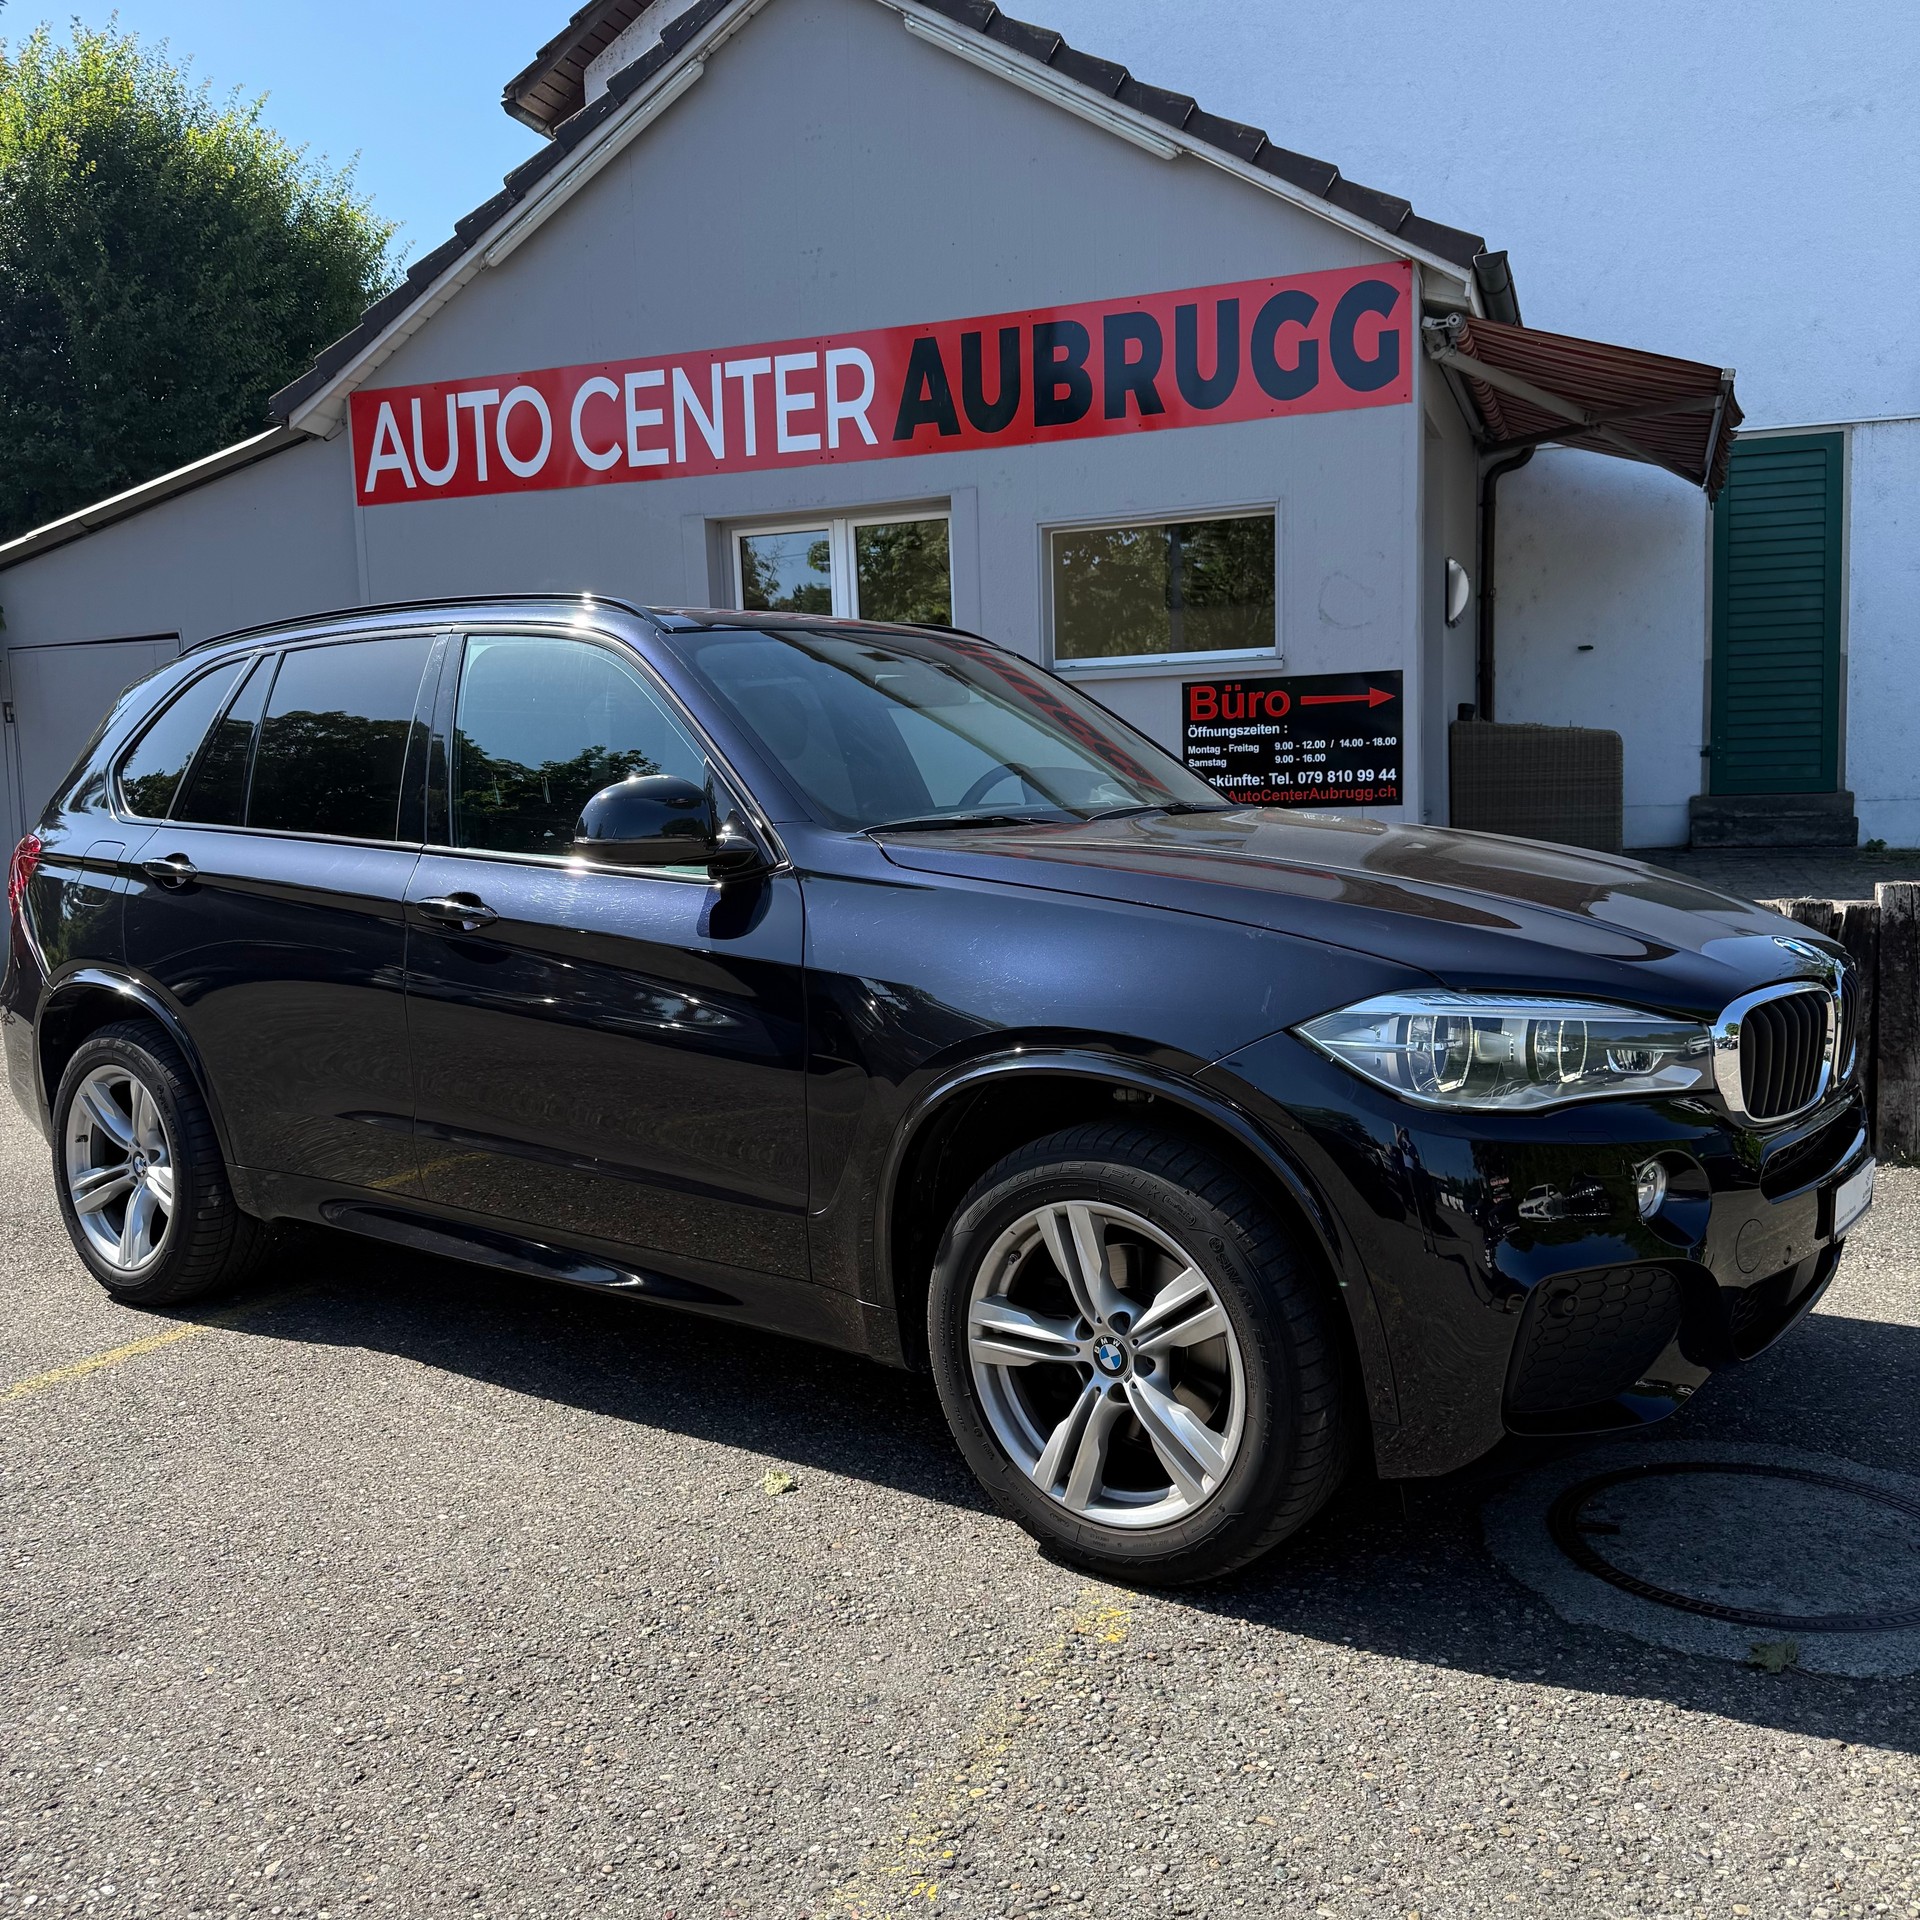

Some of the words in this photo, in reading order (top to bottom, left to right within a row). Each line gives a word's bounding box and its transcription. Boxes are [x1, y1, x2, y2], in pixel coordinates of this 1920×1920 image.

[364, 384, 552, 493] AUTO
[570, 347, 878, 471] CENTER
[892, 279, 1400, 441] AUBRUGG
[1190, 684, 1290, 720] Büro
[1187, 724, 1280, 738] Öffnungszeiten
[1187, 745, 1221, 755] Montag
[1228, 743, 1260, 753] Freitag
[1274, 741, 1294, 750] 9.00
[1302, 740, 1326, 749] 12.00
[1339, 738, 1364, 747] 14.00
[1372, 736, 1397, 746] 18.00
[1188, 758, 1227, 768] Samstag
[1274, 754, 1294, 763] 9.00
[1302, 753, 1326, 762] 16.00
[1208, 774, 1265, 787] skünfte:
[1268, 772, 1294, 785] Tel.
[1297, 770, 1323, 784] 079
[1327, 769, 1353, 783] 810
[1357, 768, 1375, 782] 99
[1378, 767, 1397, 781] 44
